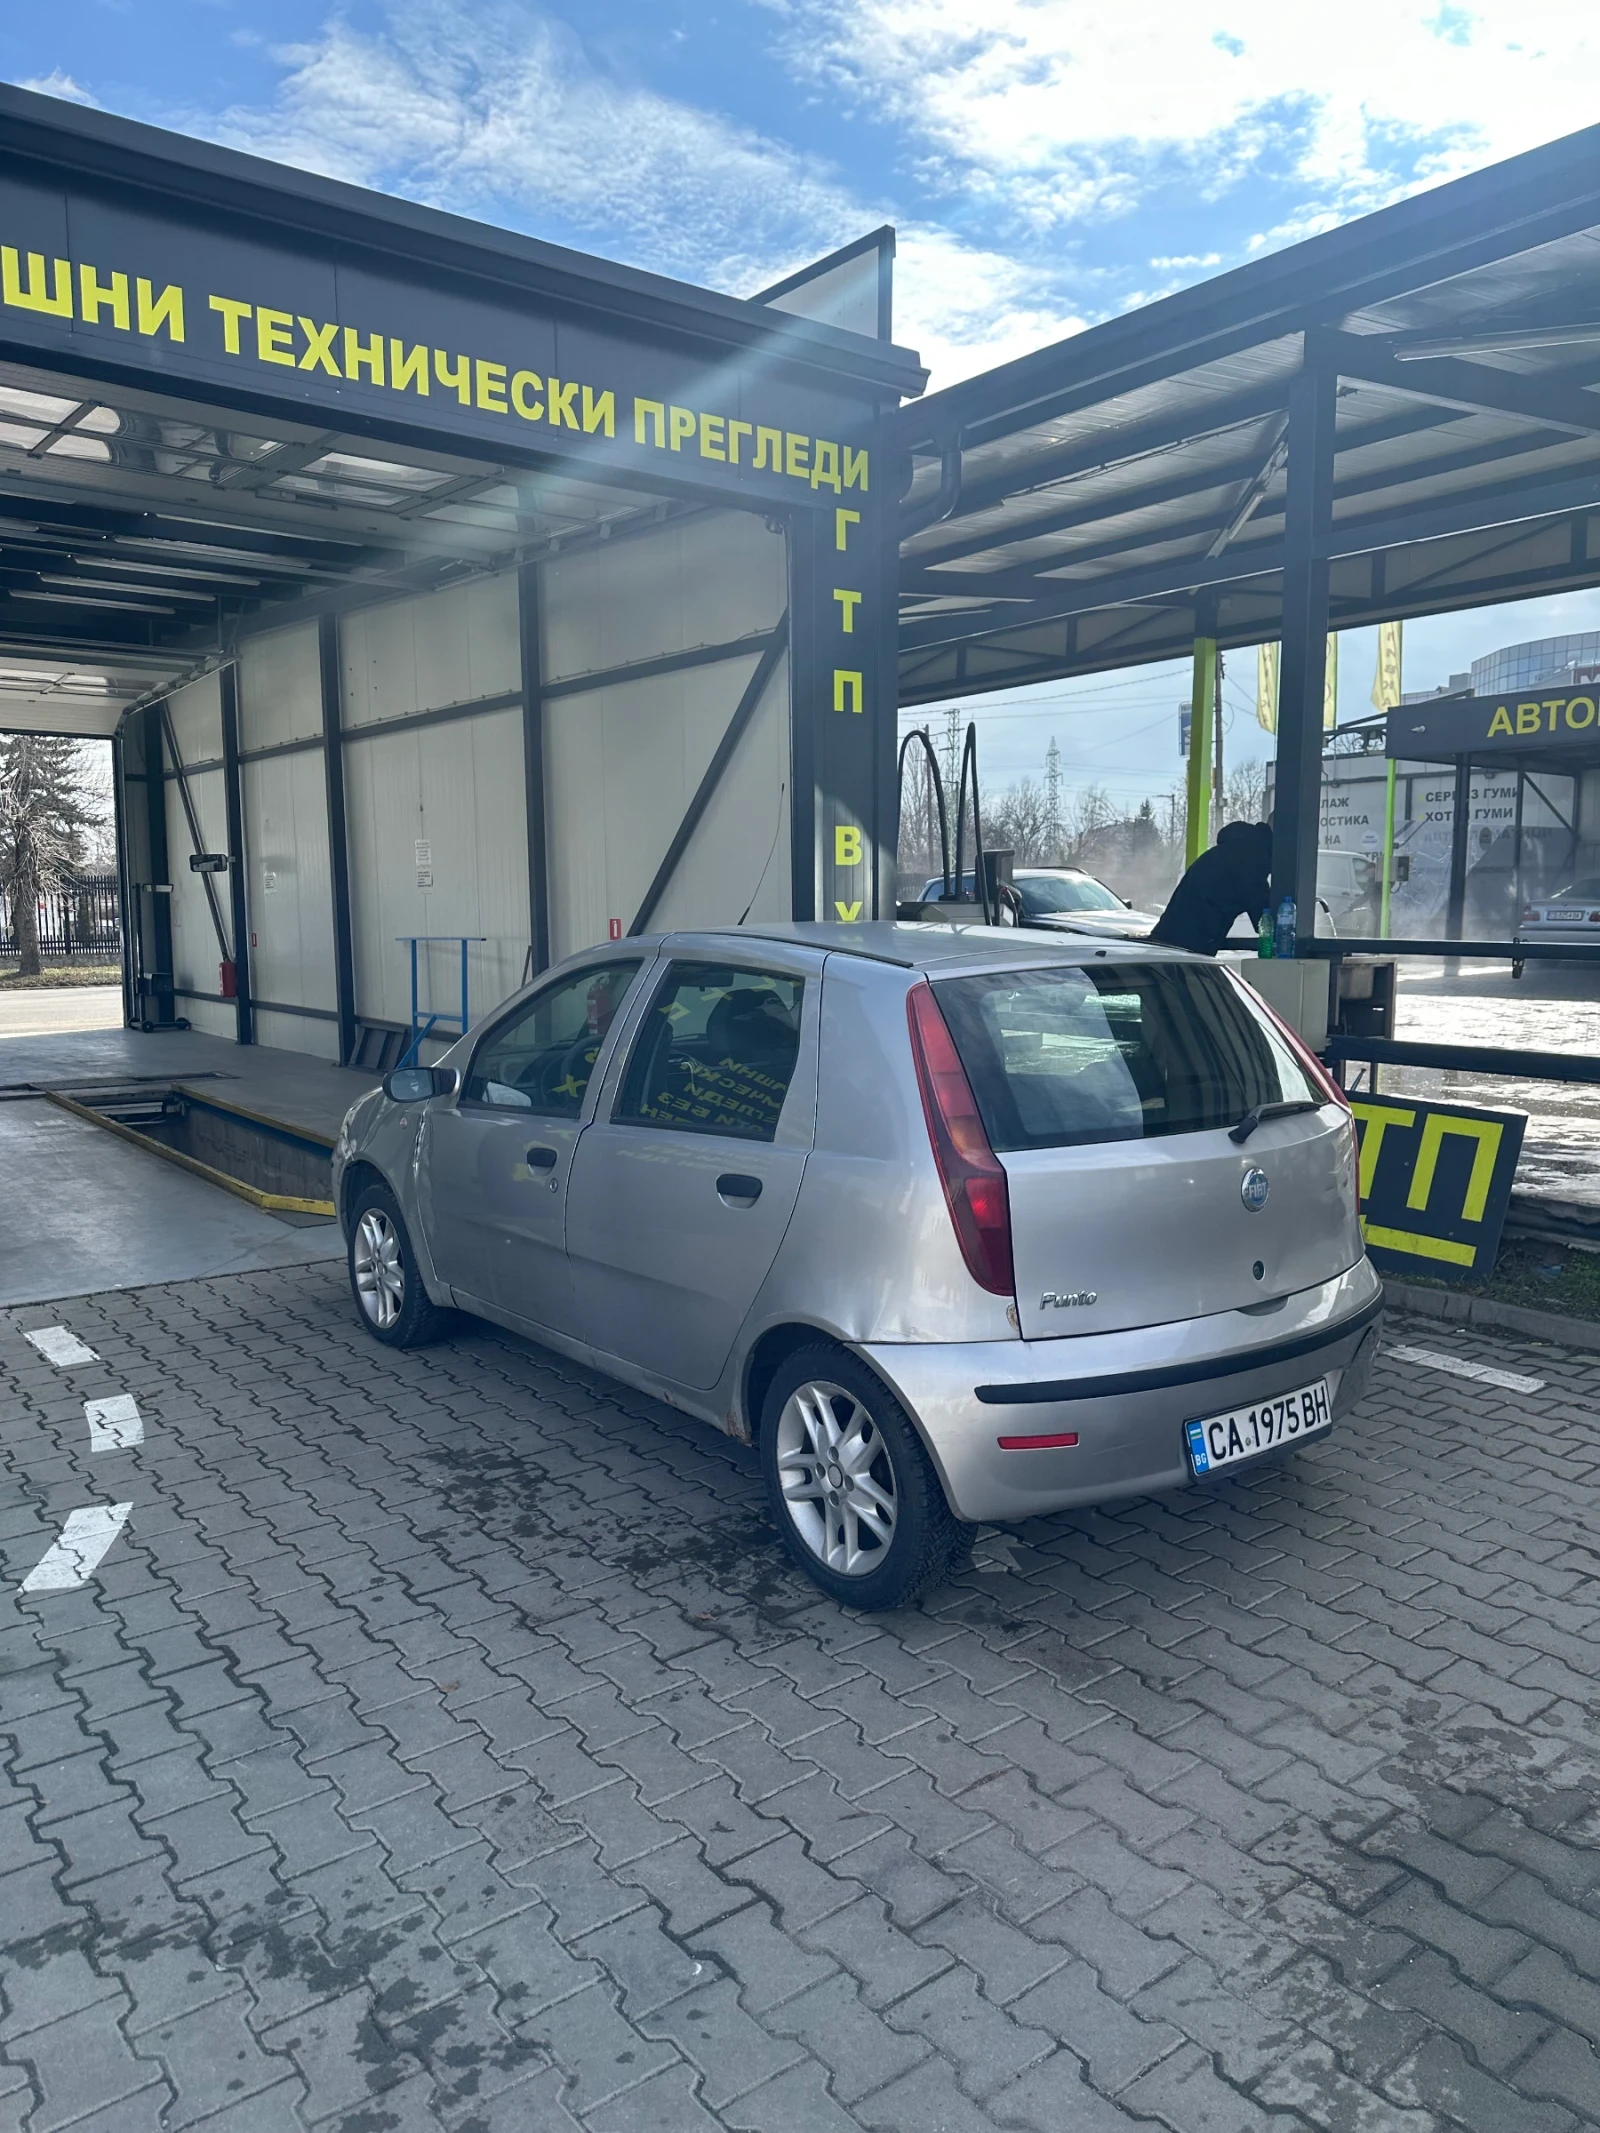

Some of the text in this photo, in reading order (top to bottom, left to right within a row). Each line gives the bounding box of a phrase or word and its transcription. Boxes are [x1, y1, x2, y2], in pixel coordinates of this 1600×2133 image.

[209, 294, 615, 439] ТЕХНИЧЕСКИ
[634, 396, 869, 494] ПРЕГЛЕДИ
[1486, 696, 1600, 738] АВТО
[1475, 807, 1513, 819] ГУМИ
[1249, 1182, 1267, 1198] FIAT
[1039, 1290, 1097, 1310] Punto
[1195, 1452, 1207, 1466] BG
